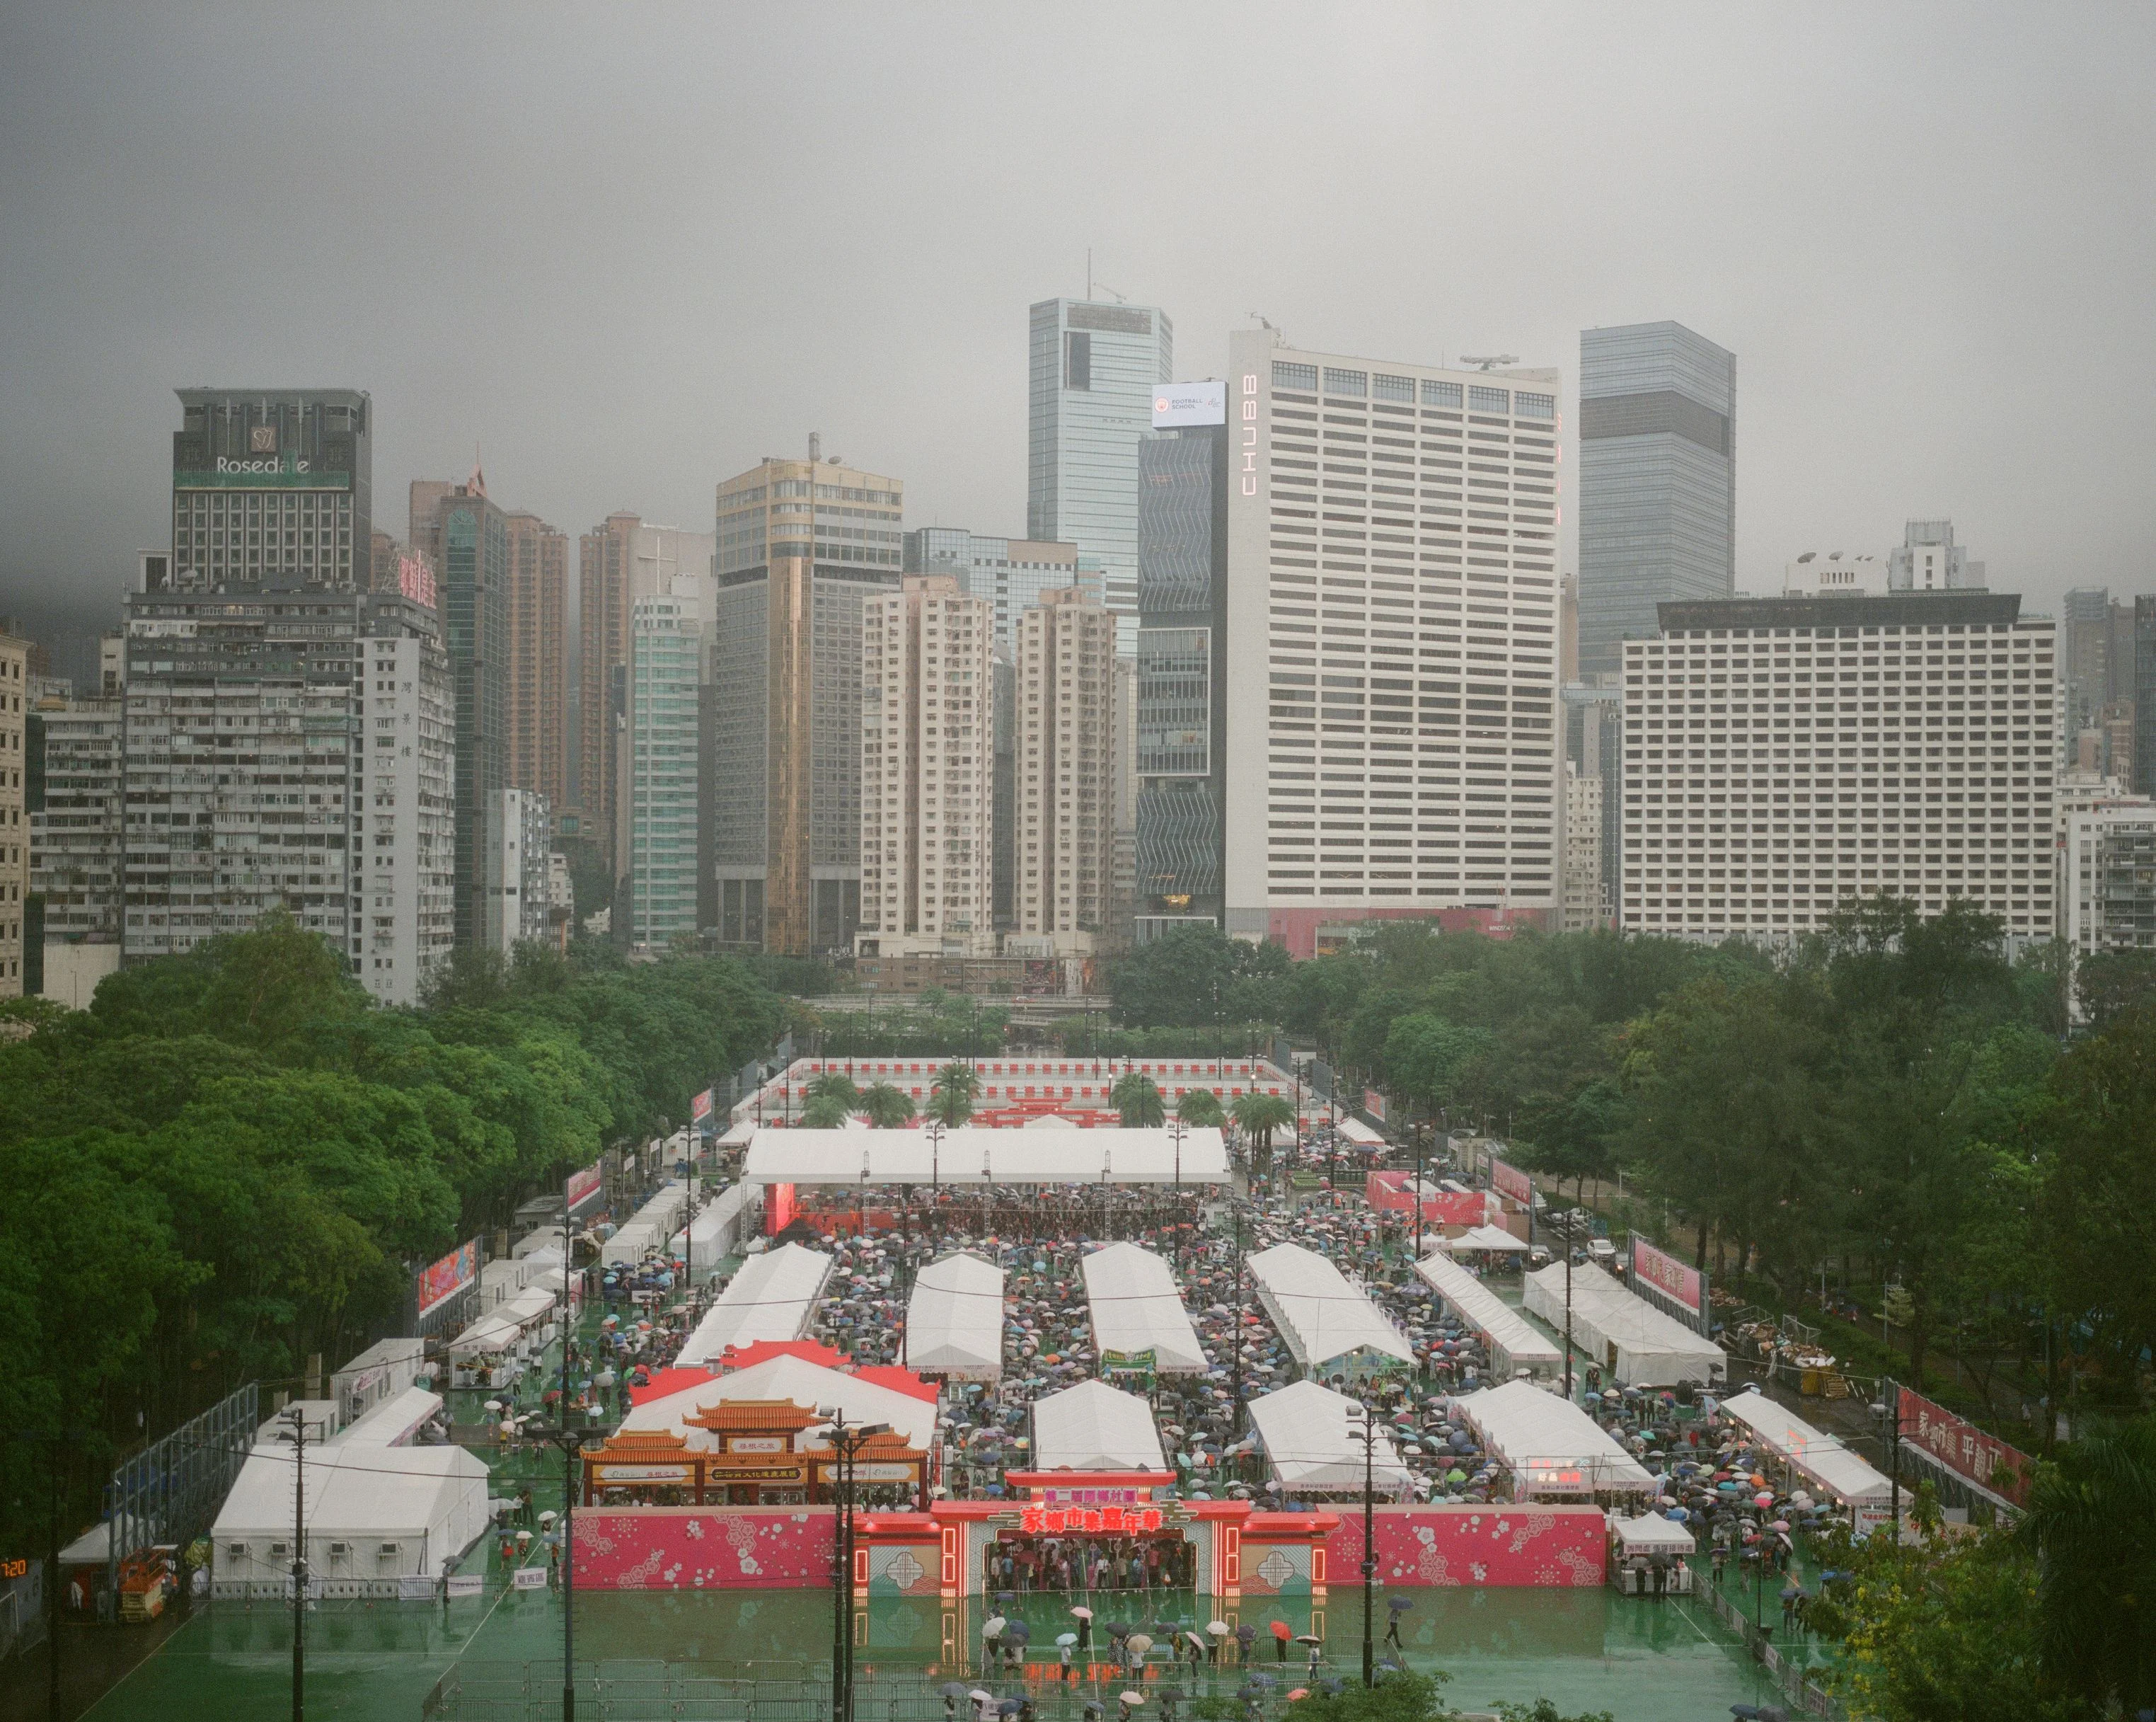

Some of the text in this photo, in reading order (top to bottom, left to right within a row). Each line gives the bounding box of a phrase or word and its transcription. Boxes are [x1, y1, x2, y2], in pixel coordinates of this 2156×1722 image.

[1243, 374, 1257, 495] CHUBB
[217, 456, 309, 474] Rosede
[1020, 1506, 1161, 1536] 家鄉市集嘉年華
